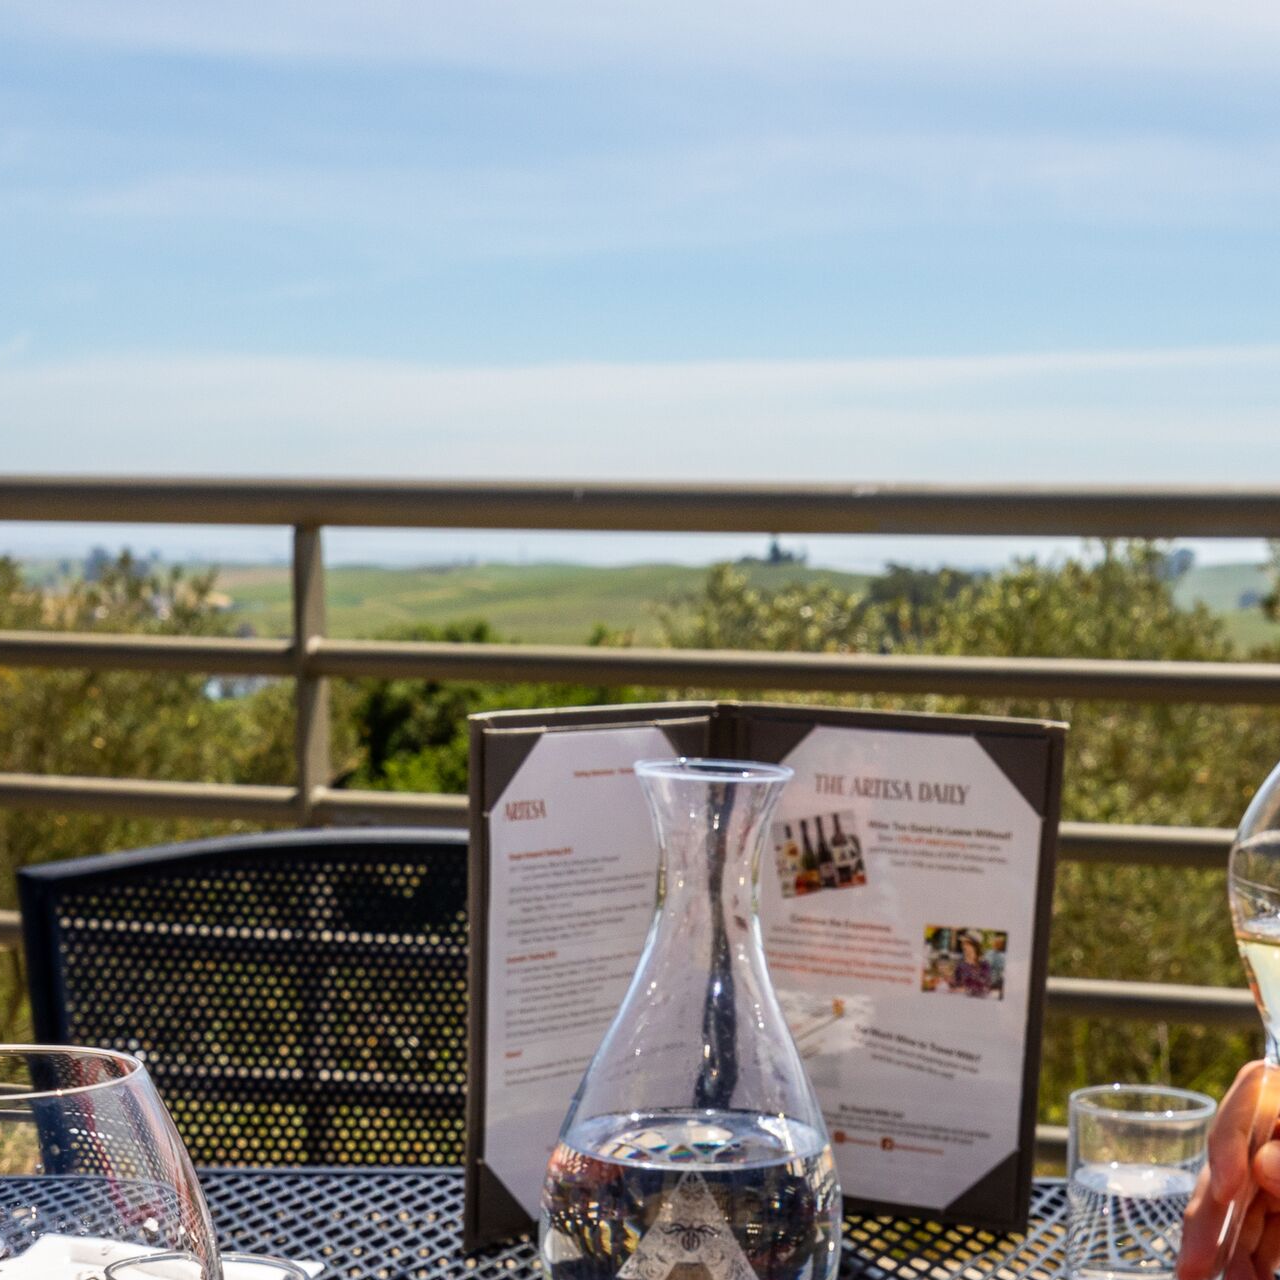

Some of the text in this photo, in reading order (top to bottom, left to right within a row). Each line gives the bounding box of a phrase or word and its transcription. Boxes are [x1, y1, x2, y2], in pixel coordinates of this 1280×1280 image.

[815, 773, 970, 806] THE ARTESA DAILY
